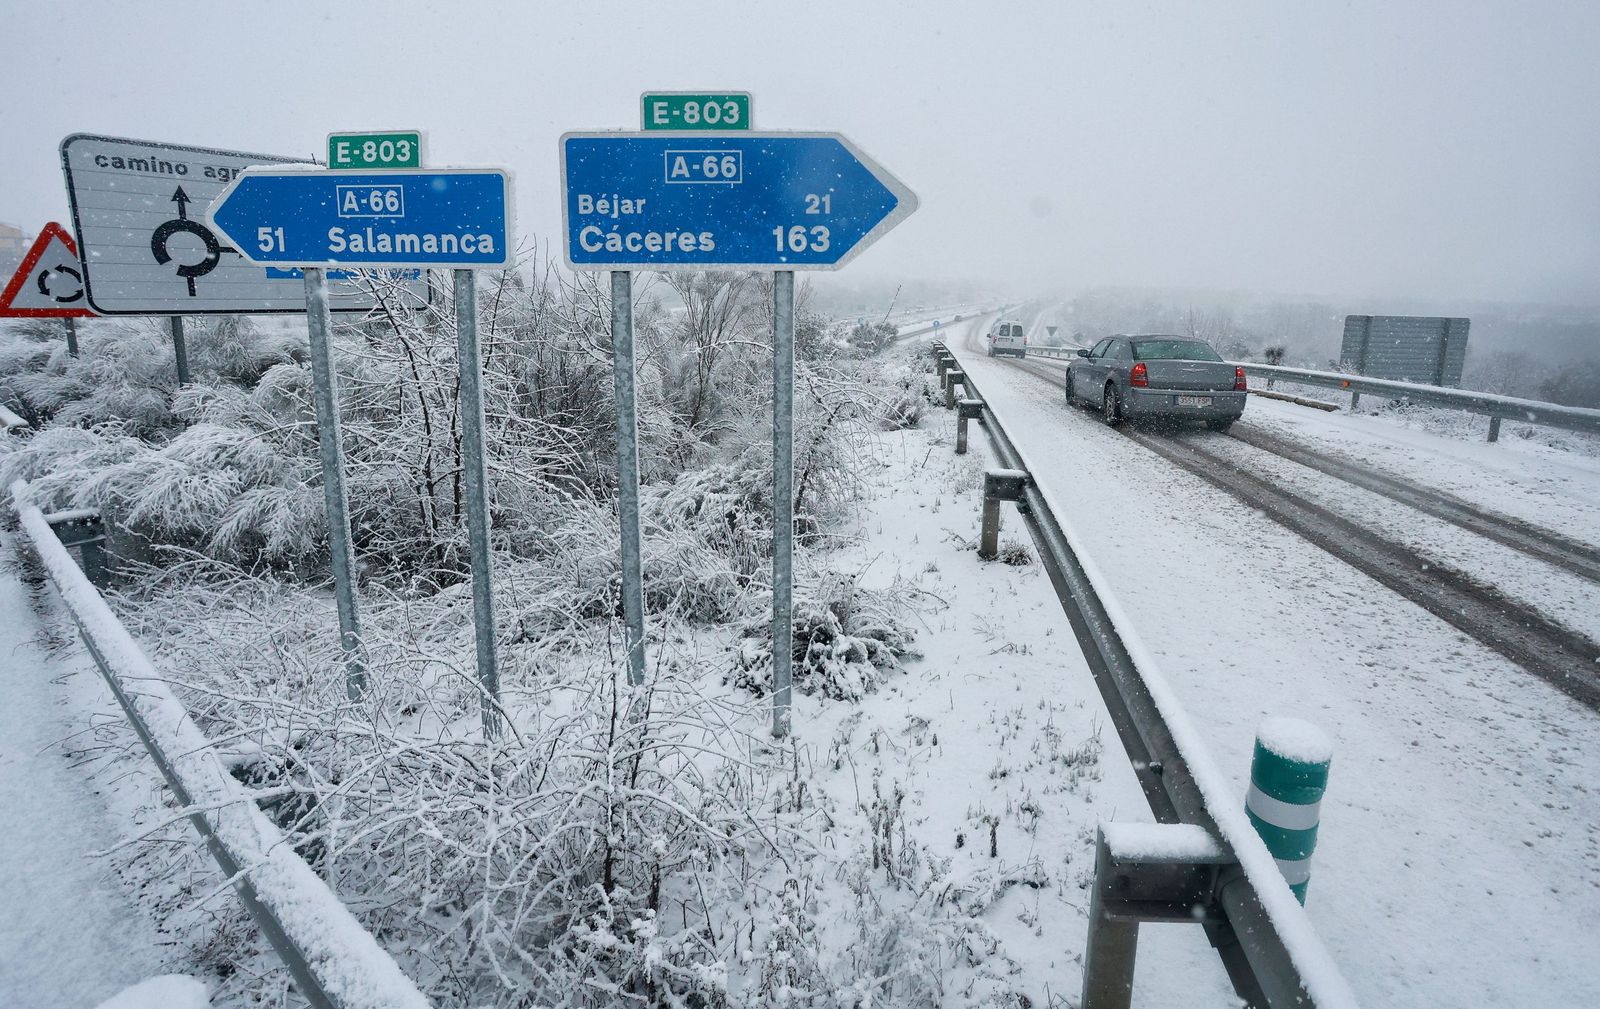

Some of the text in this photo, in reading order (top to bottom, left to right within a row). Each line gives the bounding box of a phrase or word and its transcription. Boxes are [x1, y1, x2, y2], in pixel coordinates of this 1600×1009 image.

[653, 101, 740, 124] E-803
[336, 140, 411, 163] E-803
[95, 153, 189, 176] camino
[671, 156, 737, 178] A-66
[343, 190, 400, 213] A-66
[578, 194, 831, 218] Béjar 21
[257, 227, 494, 255] 51 Salamanca
[579, 224, 830, 253] Cáceres 163
